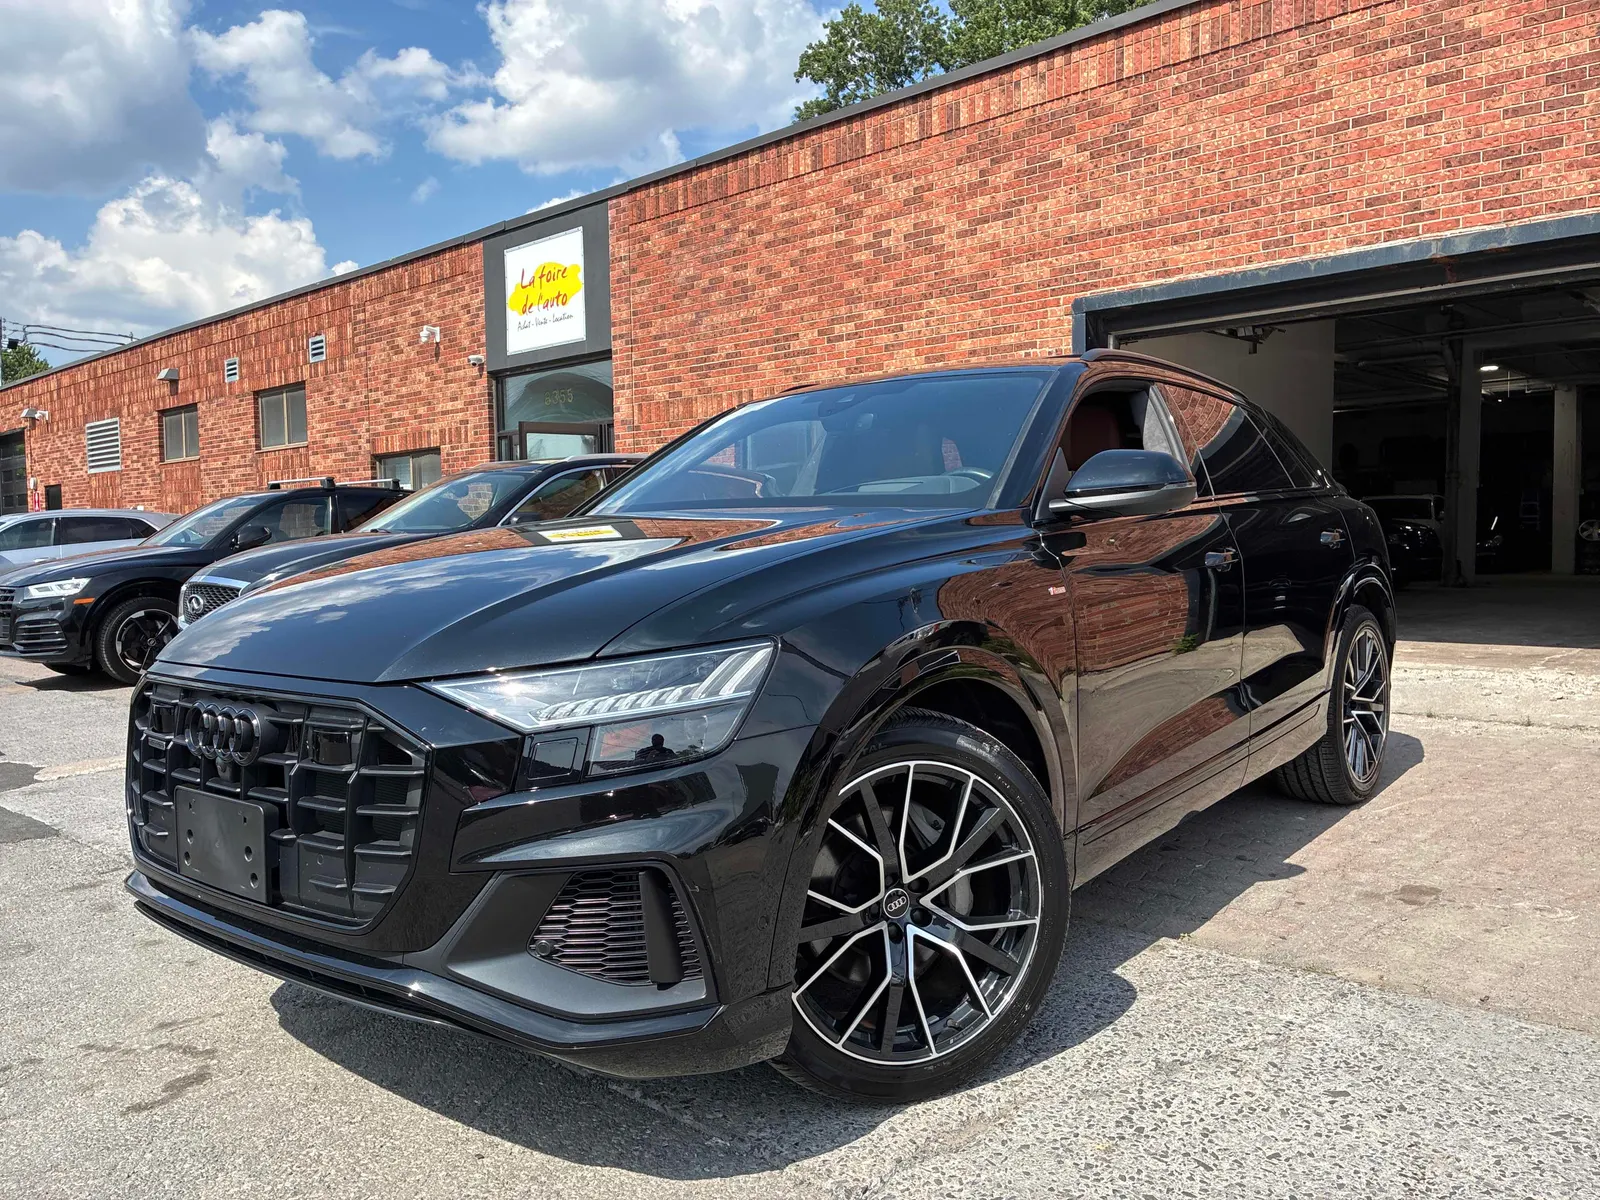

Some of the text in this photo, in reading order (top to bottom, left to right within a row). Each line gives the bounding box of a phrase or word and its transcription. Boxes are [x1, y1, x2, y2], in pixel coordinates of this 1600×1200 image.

[521, 265, 568, 290] La foire
[521, 290, 568, 316] de l'auto
[517, 320, 531, 332] Achat
[552, 312, 574, 323] Location
